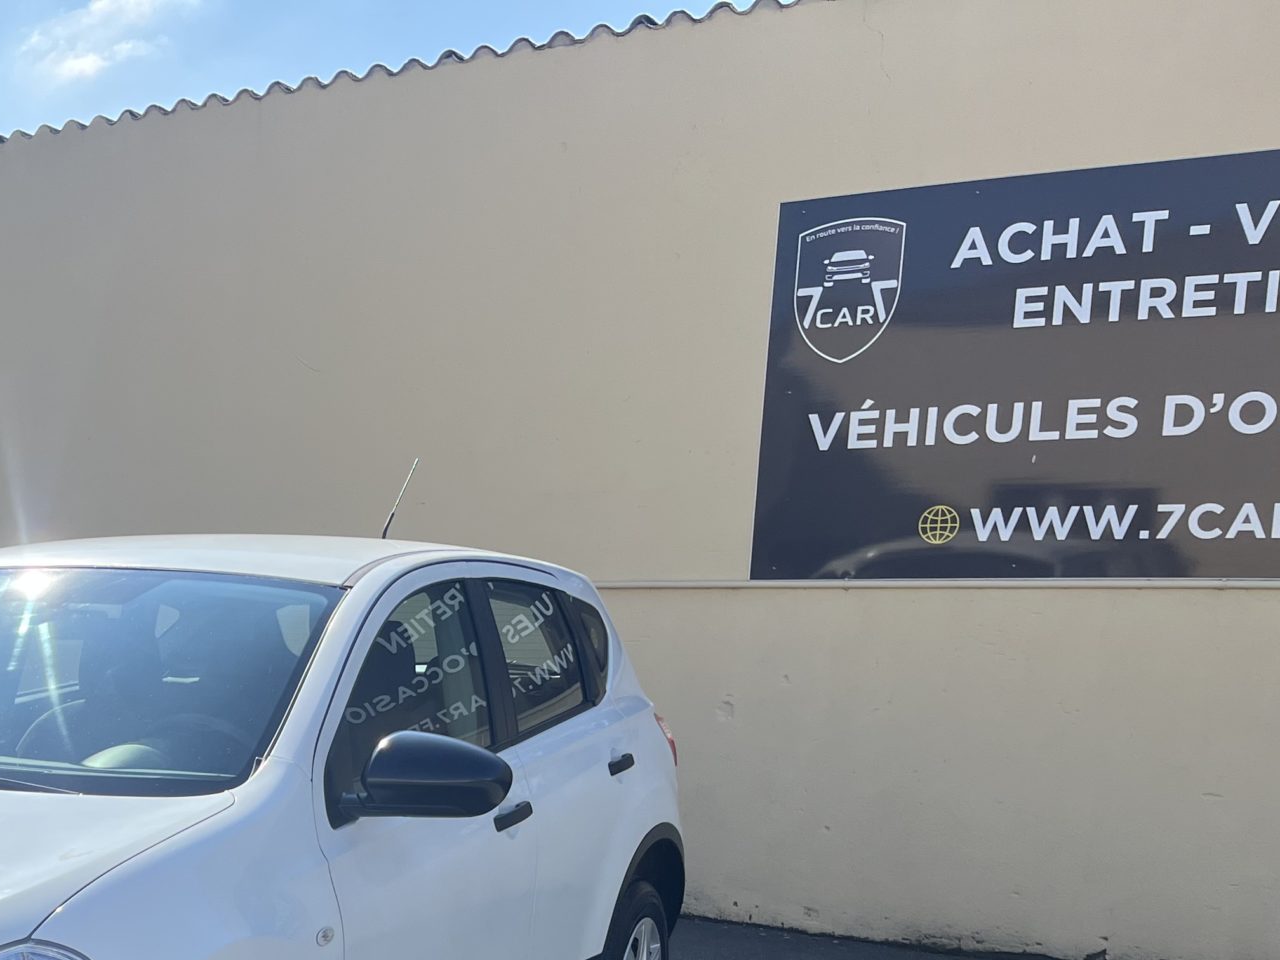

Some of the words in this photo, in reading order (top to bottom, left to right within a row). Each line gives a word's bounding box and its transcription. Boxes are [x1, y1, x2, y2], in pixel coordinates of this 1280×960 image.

[817, 229, 836, 238] route
[837, 225, 852, 233] vers
[861, 224, 895, 233] confiance
[950, 210, 1169, 268] ACHAT
[1013, 270, 1280, 328] ENTRETI
[809, 399, 1138, 451] VÉHICULES
